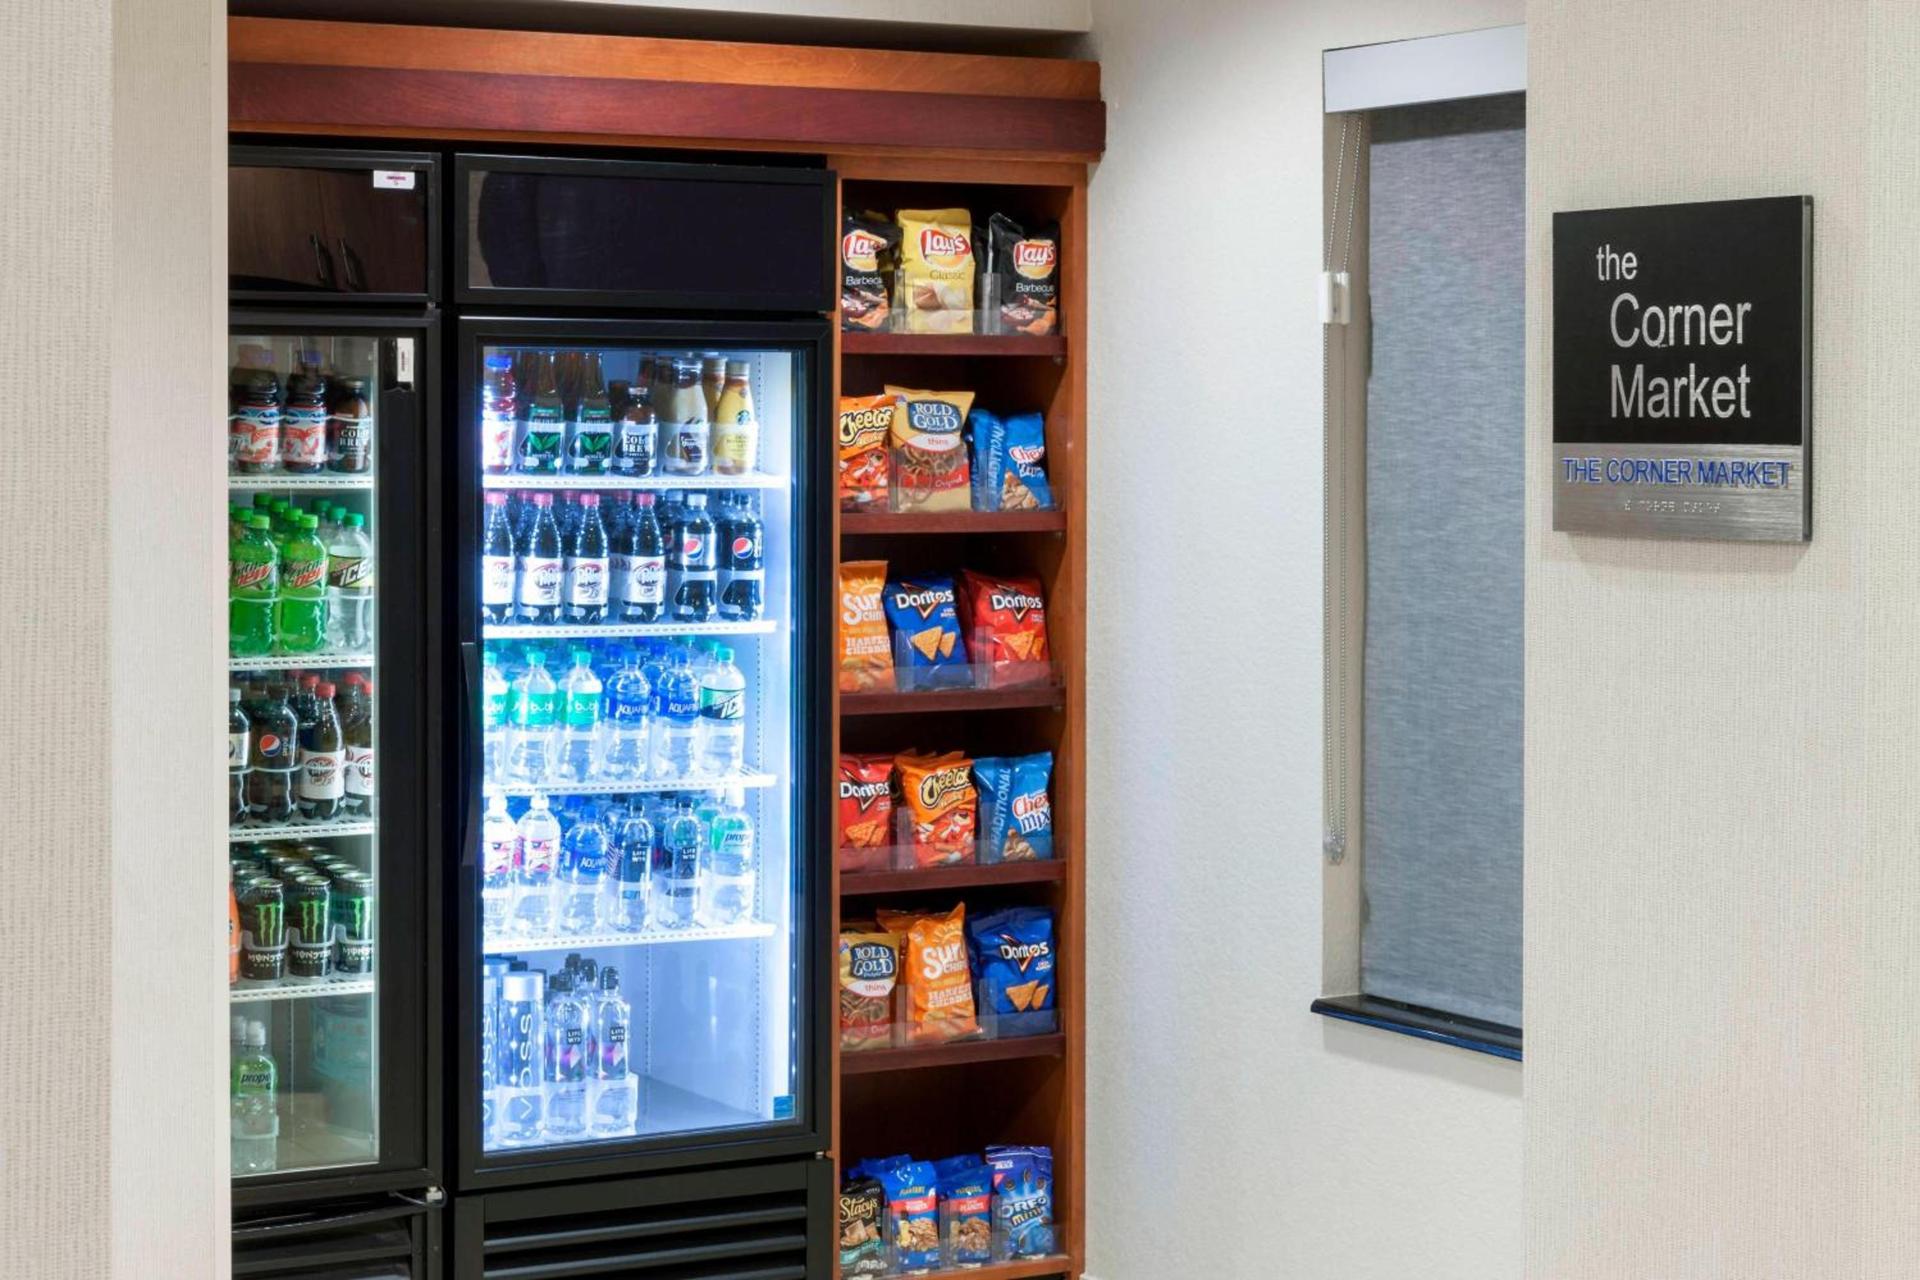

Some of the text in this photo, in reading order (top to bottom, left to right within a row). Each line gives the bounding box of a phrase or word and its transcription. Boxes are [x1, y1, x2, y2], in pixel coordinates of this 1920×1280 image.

[1595, 243, 1638, 281] the
[1609, 293, 1752, 348] Corner
[1609, 362, 1752, 419] Market
[914, 402, 953, 417] ROLD
[913, 414, 958, 429] GOLD
[1562, 458, 1791, 488] THE CORNER MARKET
[895, 590, 955, 610] Doritos
[990, 594, 1043, 611] Doritos
[840, 781, 890, 799] Doritos
[1012, 793, 1049, 818] Chex
[853, 944, 889, 960] ROLD
[999, 941, 1050, 961] Doritos
[853, 957, 893, 975] GOLD
[840, 1196, 878, 1223] Stacy's
[1001, 1196, 1047, 1219] OREO
